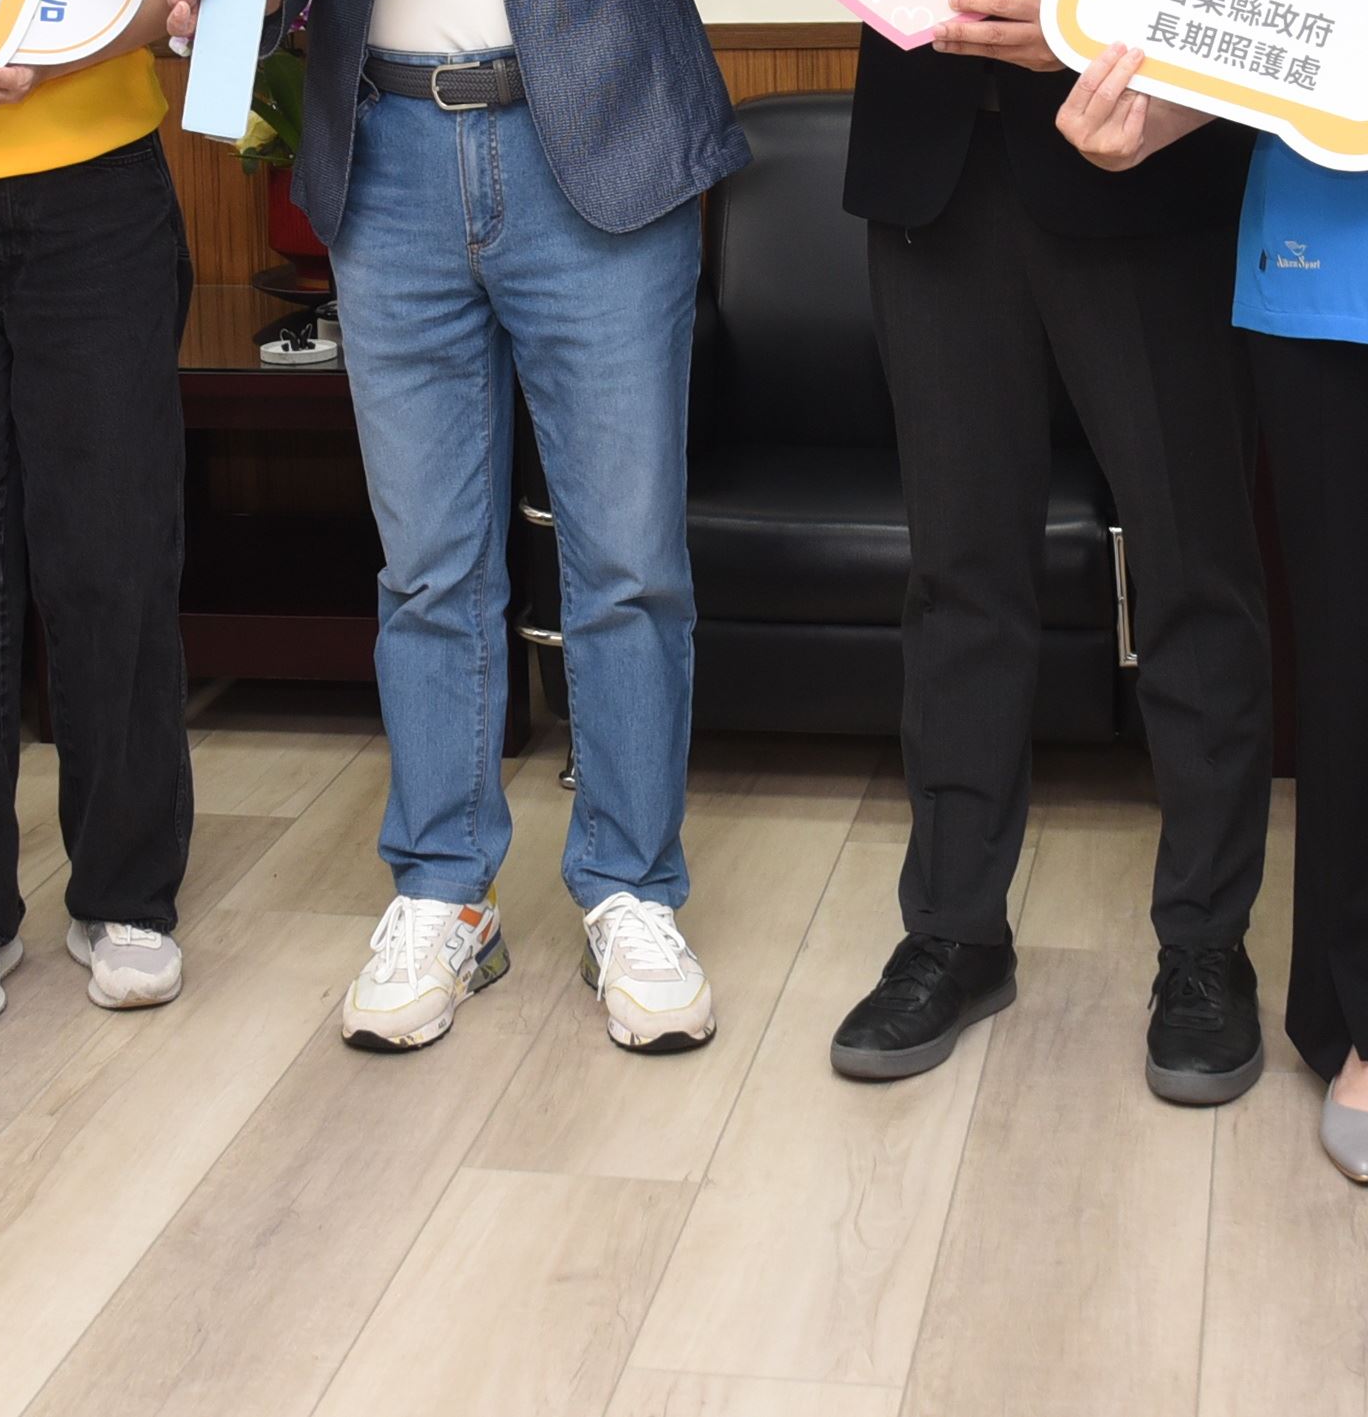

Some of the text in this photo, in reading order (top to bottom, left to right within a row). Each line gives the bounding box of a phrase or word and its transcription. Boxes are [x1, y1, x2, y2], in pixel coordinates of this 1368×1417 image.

[1146, 11, 1321, 91] 長期照護處
